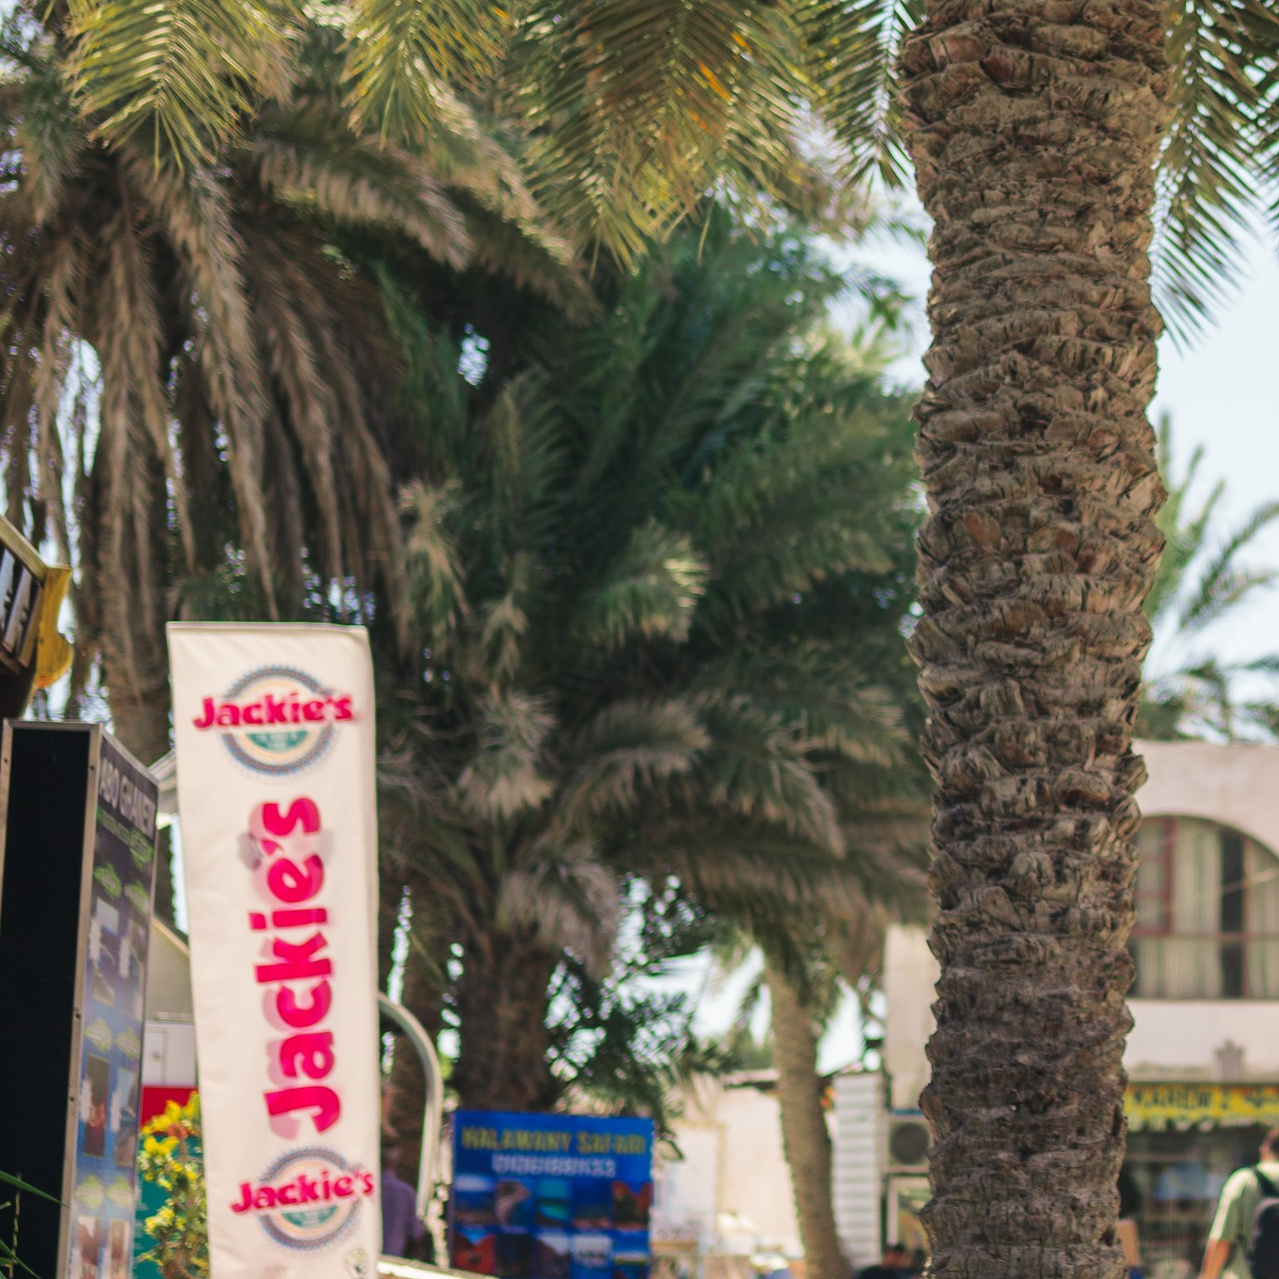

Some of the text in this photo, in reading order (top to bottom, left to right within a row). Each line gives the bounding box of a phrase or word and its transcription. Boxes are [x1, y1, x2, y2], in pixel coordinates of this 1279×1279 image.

[193, 691, 353, 729] Jackie's
[248, 797, 341, 1134] Jackie's
[230, 1169, 374, 1214] Jackie's
